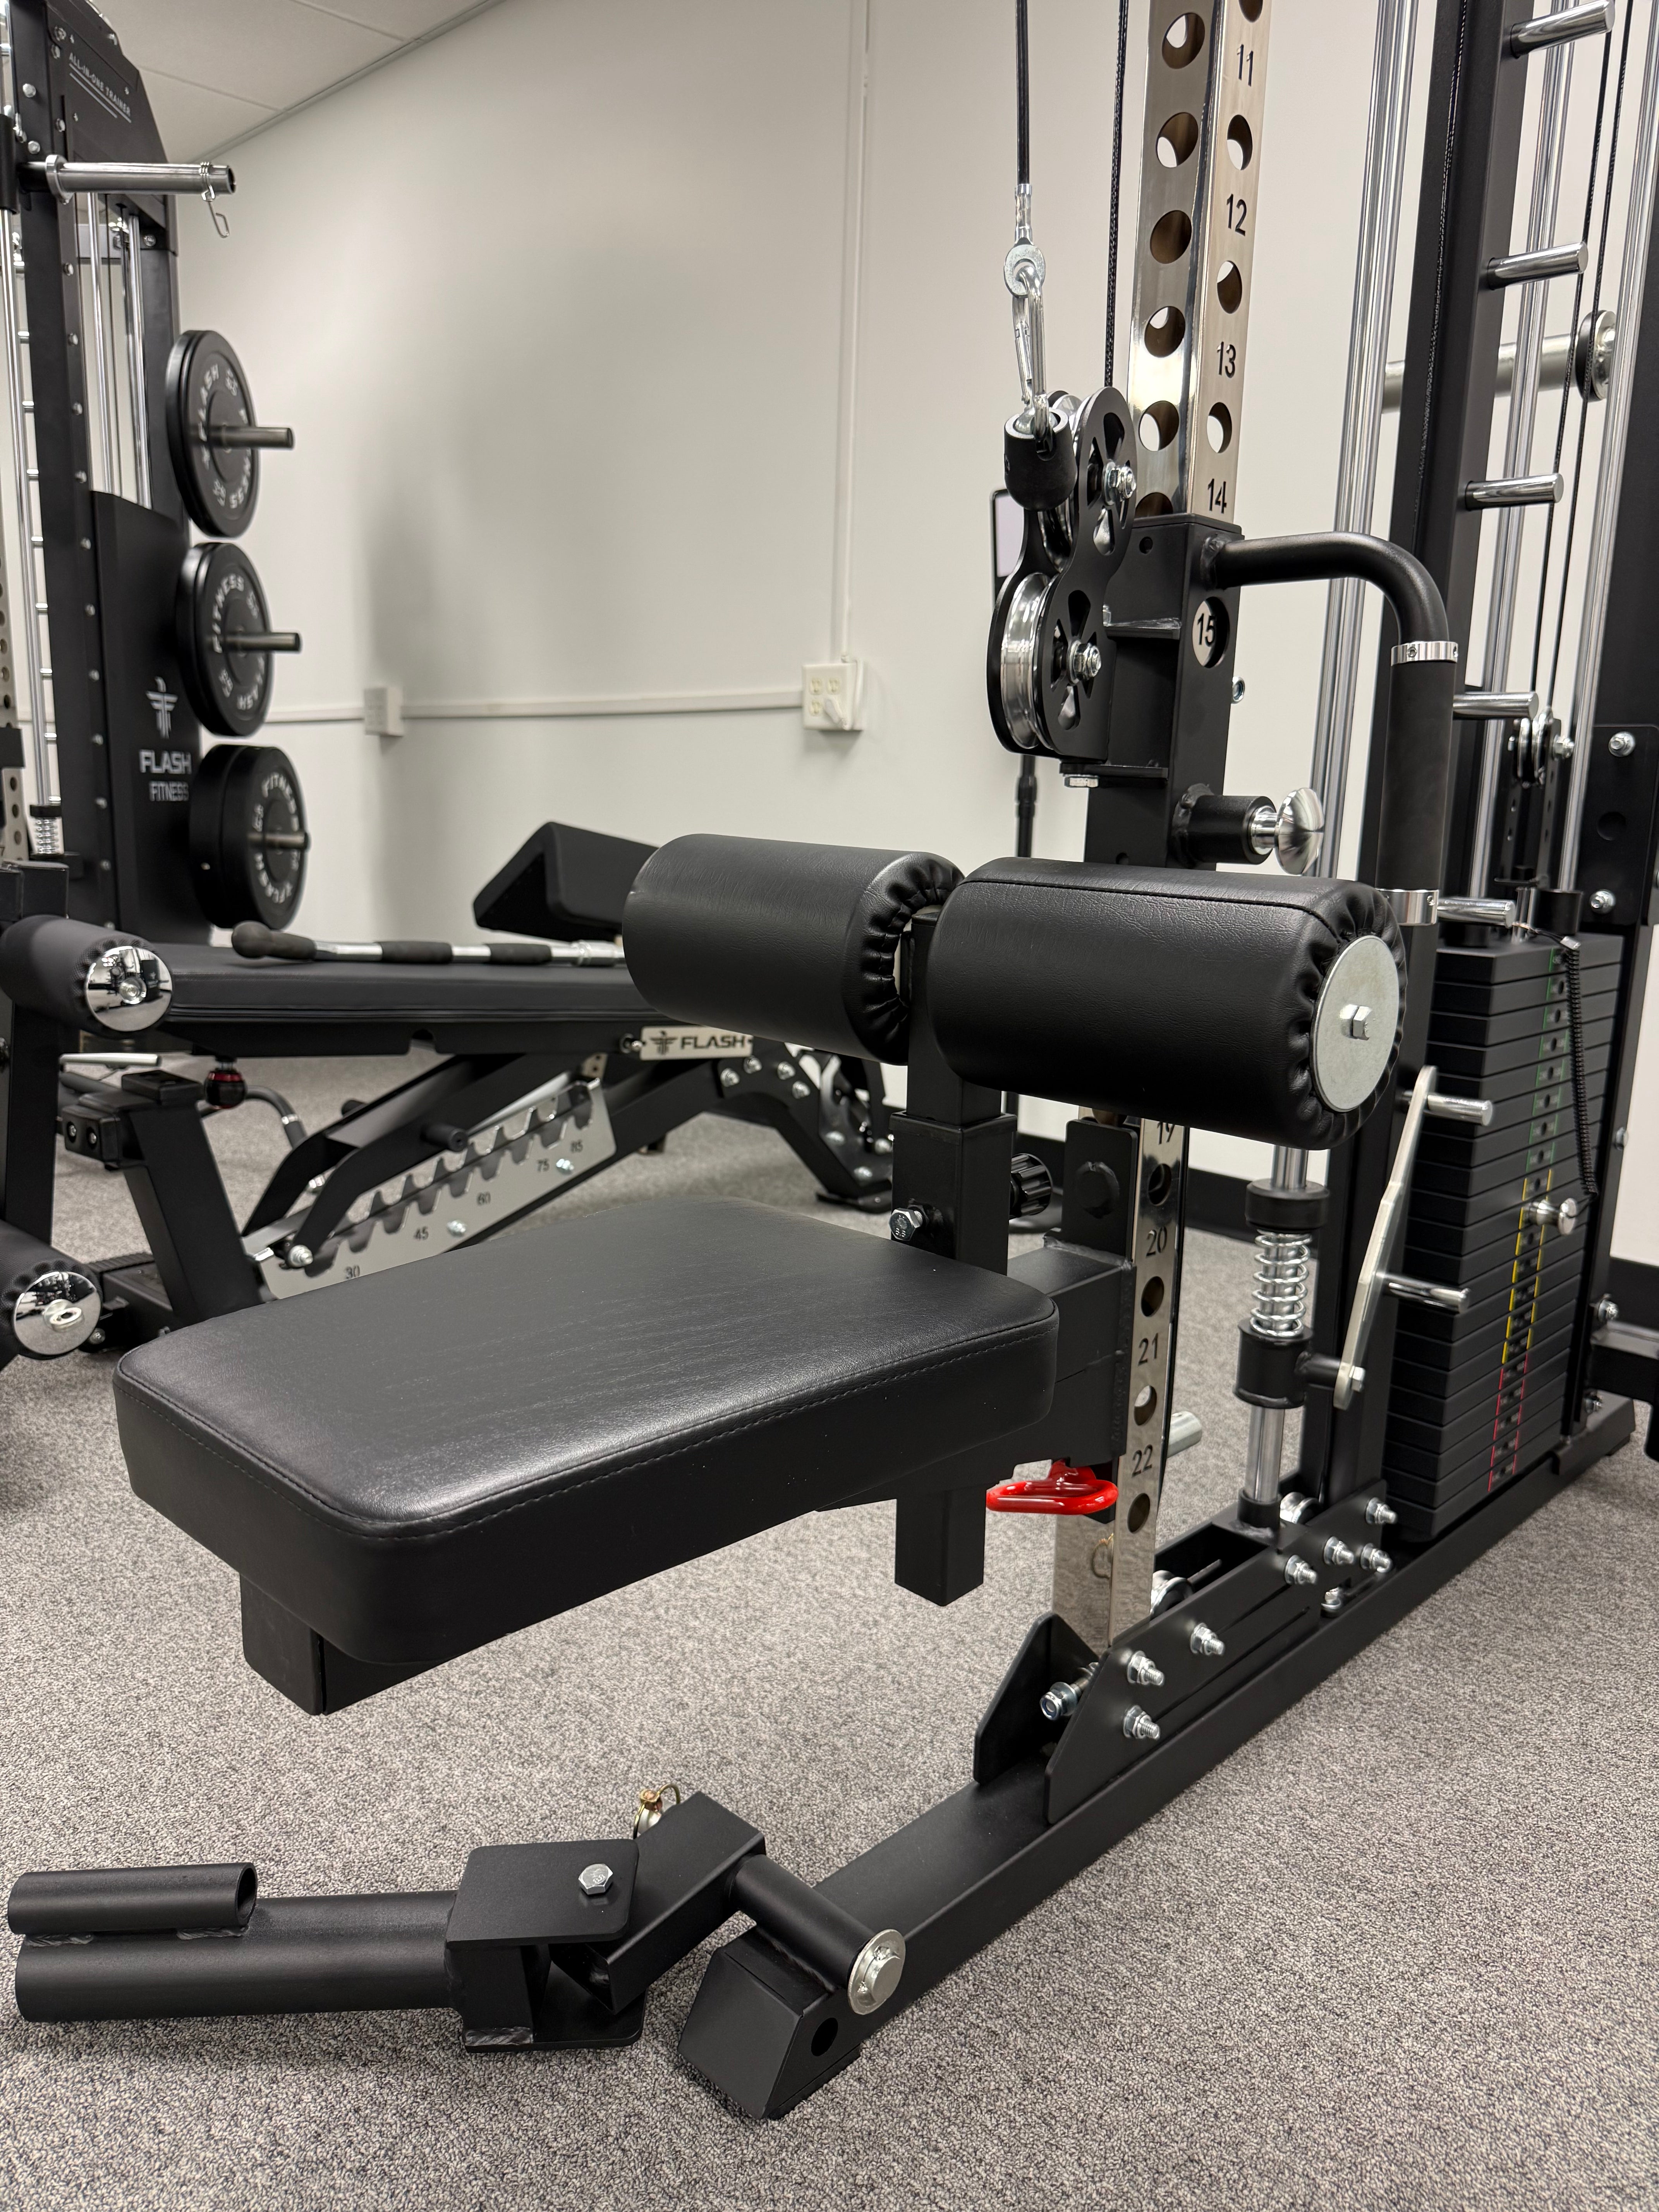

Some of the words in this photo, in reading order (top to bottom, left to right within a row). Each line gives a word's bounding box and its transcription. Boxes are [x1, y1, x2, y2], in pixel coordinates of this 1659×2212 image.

[1237, 43, 1253, 87] 11
[69, 52, 104, 91] ALL-IN-ONE
[105, 86, 131, 117] TRAINER
[1226, 193, 1247, 237] 12
[1217, 341, 1236, 378] 13
[1207, 478, 1227, 514] 14
[1197, 613, 1215, 647] 15
[139, 749, 192, 774] FLASH
[149, 780, 189, 802] FITNESS
[681, 1035, 745, 1049] FLASH
[537, 1158, 550, 1172] 75
[414, 1225, 429, 1241] 45
[1146, 1226, 1168, 1258] 20
[344, 1265, 361, 1279] 30
[1138, 1333, 1158, 1367] 21
[1131, 1444, 1153, 1478] 22
